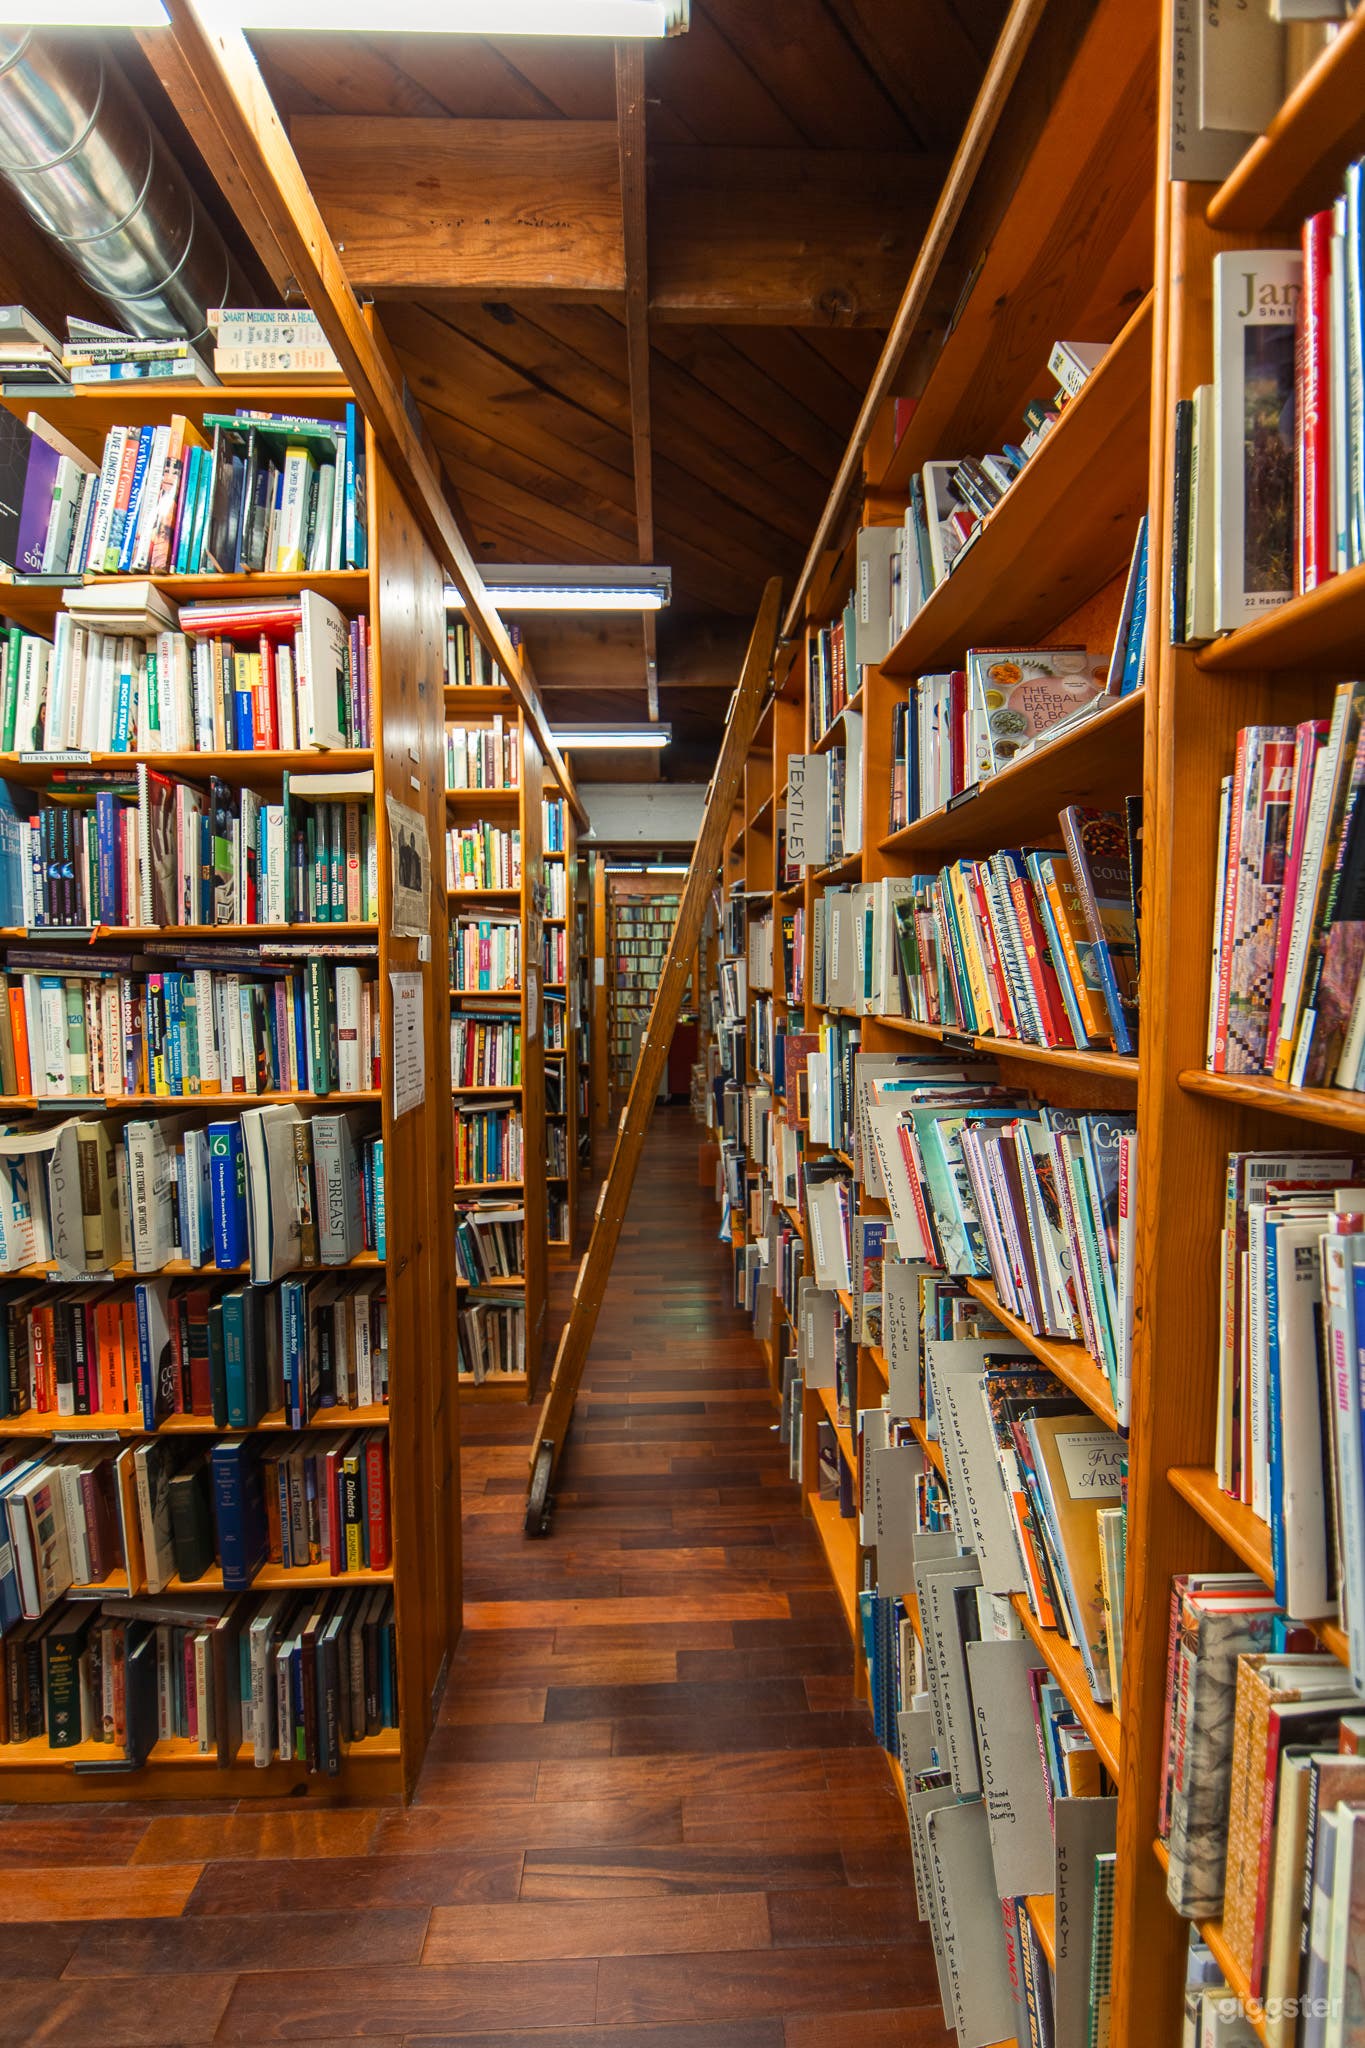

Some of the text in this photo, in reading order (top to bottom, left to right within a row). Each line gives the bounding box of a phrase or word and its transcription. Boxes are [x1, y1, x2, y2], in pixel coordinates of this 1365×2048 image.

[223, 311, 245, 322] SMART
[247, 311, 275, 322] MEDICINE
[278, 312, 290, 322] FOR
[112, 431, 123, 450] LIVE
[123, 446, 136, 471] Food
[105, 451, 121, 484] LONGER
[1244, 598, 1256, 606] 22
[147, 655, 158, 706] Deep Nutrition
[1021, 686, 1048, 695] THE
[1023, 694, 1083, 703] HERBAL
[117, 682, 130, 741] ROCK STEADY
[1024, 703, 1064, 712] BATH
[1033, 712, 1042, 720] &
[788, 756, 805, 860] TEXTILES
[1303, 852, 1312, 877] The
[1323, 792, 1358, 928] The Yarn Stash Workbook
[269, 847, 279, 911] Natural Healing
[1226, 867, 1237, 909] Bright
[1297, 880, 1307, 915] New
[1019, 914, 1032, 940] DAD
[1224, 910, 1234, 942] Ideas
[1055, 905, 1063, 922] How
[1063, 931, 1071, 948] Make
[1067, 949, 1075, 967] Money
[1077, 984, 1085, 1001] Etsy
[67, 1014, 83, 1025] 120
[1217, 979, 1228, 1027] QUILTING
[53, 1027, 62, 1059] Protocol
[213, 1136, 227, 1156] 6
[874, 1127, 900, 1219] CANDLEMAKING
[328, 1159, 345, 1240] THE BREAST
[378, 1222, 386, 1238] SICK
[1266, 1245, 1275, 1282] PLAIN
[888, 1292, 898, 1371] DECOUPAGE
[898, 1296, 909, 1352] COLLAGE
[34, 1326, 43, 1363] GUT
[946, 1387, 986, 1558] FLOWERS POTPOURRI
[291, 1477, 303, 1532] Last Resort
[346, 1479, 355, 1518] Diabetes
[930, 1673, 944, 1737] OUTDOOR
[931, 1584, 962, 1794] GIFT WRAP TABLE SETTING
[976, 1706, 994, 1785] GLASS
[1035, 1722, 1044, 1754] GLASS
[989, 1811, 1016, 1823] Painting
[1057, 1846, 1069, 1959] HOLIDAYS
[1017, 1905, 1036, 2013] ESSENTIALS OF
